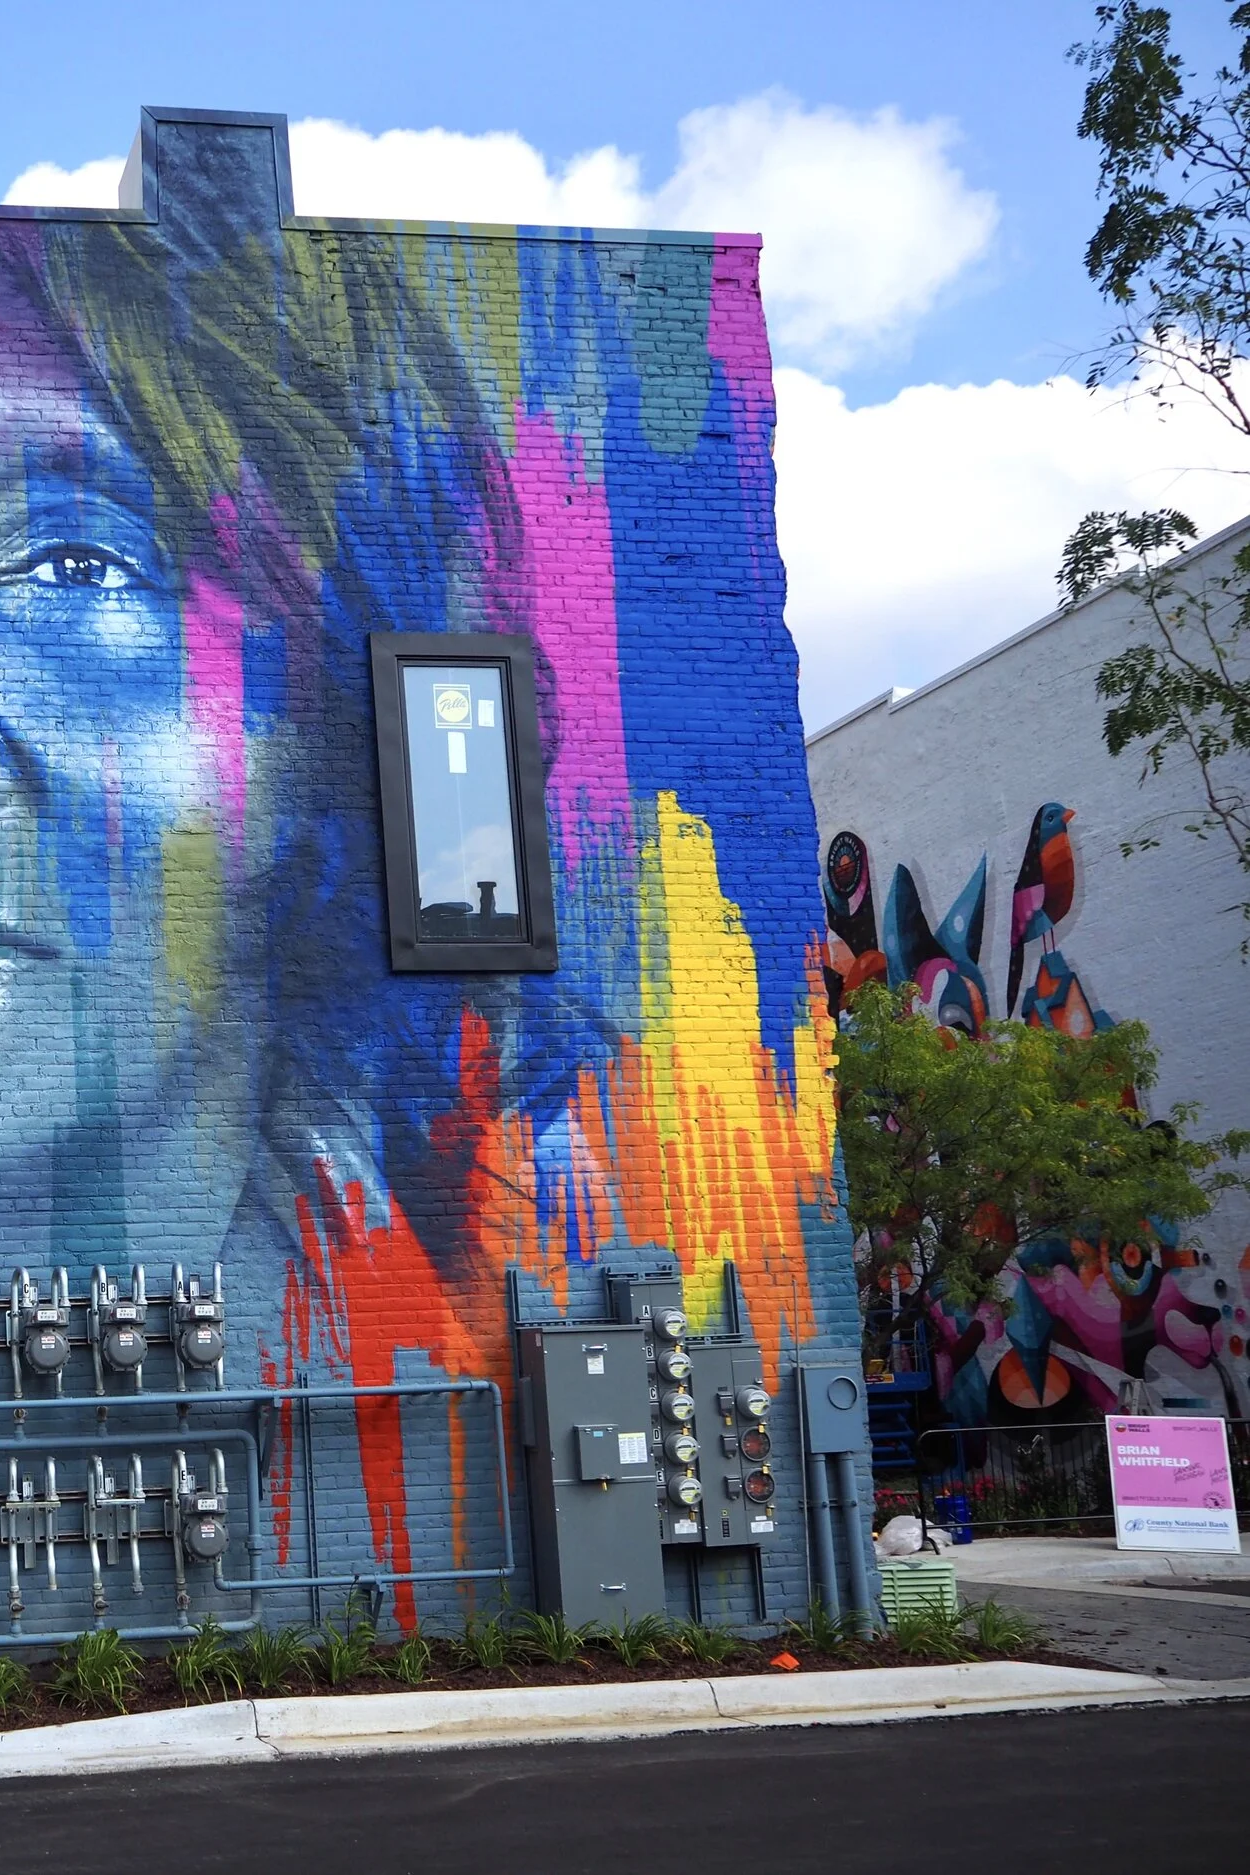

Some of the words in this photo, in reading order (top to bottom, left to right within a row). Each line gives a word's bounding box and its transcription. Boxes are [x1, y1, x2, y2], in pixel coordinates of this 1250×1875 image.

[177, 1281, 184, 1292] A
[1117, 1445, 1160, 1456] BRIAN
[1118, 1456, 1191, 1467] WHITFIELD
[1146, 1518, 1172, 1527] County
[1174, 1519, 1207, 1528] National
[1209, 1520, 1229, 1528] Bank
